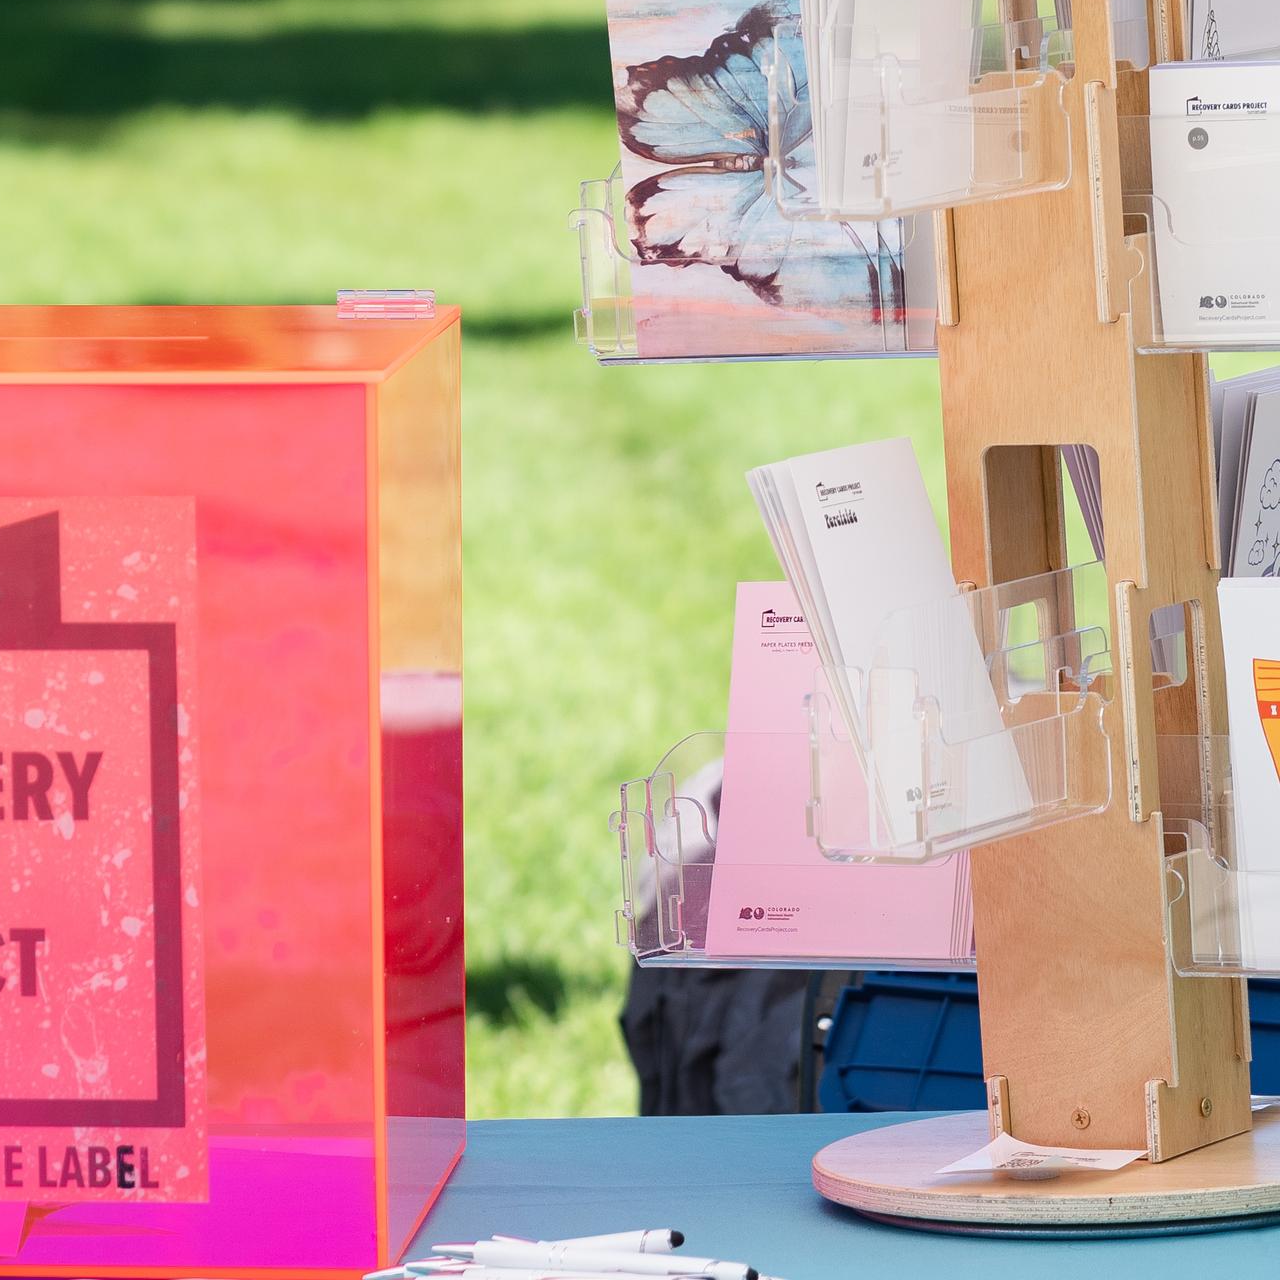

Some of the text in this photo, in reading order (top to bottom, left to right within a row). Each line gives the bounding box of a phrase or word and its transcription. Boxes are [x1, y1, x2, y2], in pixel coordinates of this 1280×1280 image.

[1191, 101, 1268, 111] RECOVERY CARDS PROJECT
[38, 1144, 160, 1189] LABEL
